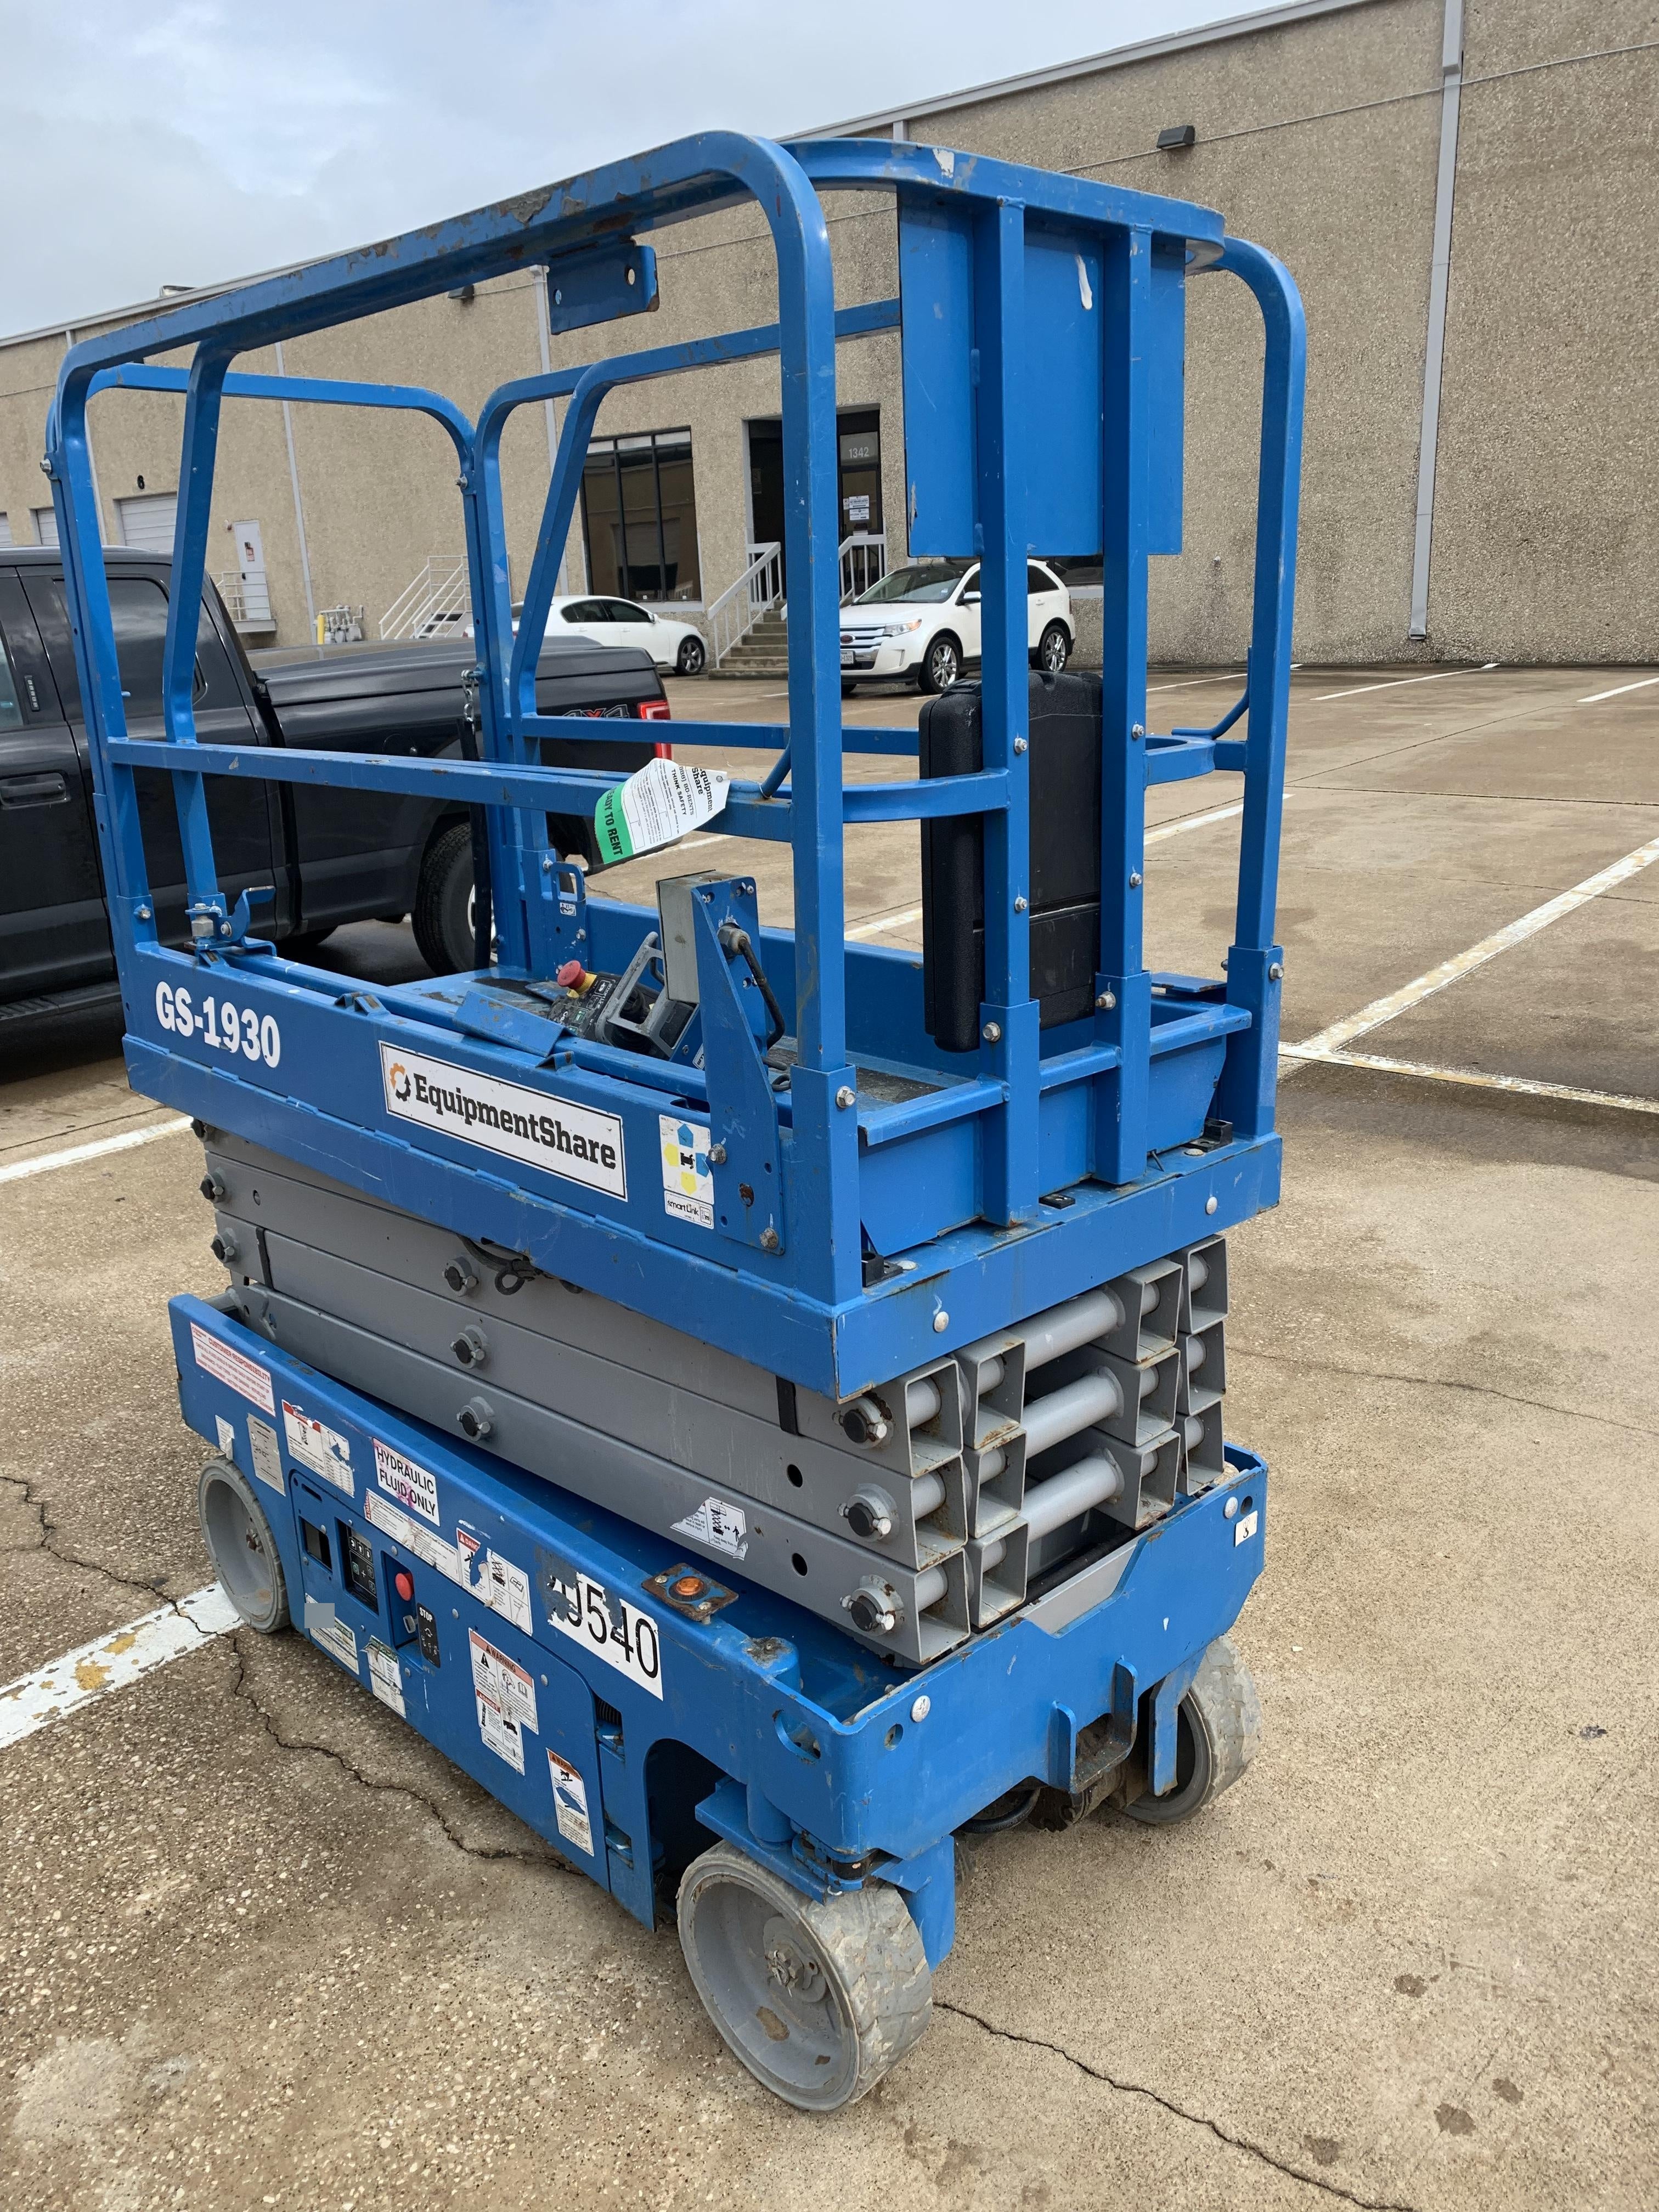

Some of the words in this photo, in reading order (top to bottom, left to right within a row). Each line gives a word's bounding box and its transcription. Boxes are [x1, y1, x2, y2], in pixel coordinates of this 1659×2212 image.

[849, 447, 870, 458] 1342
[137, 475, 145, 489] 6
[671, 769, 680, 790] THINK
[678, 791, 687, 815] SAFETY
[692, 768, 703, 795] Share
[699, 768, 713, 812] quipment
[605, 812, 614, 826] TO
[607, 828, 623, 855] RENT
[156, 981, 280, 1068] GS-1930
[413, 1073, 617, 1170] EquipmentShare
[208, 1338, 232, 1357] CUSTOMER
[377, 1447, 434, 1494] HYDRAULIC
[380, 1469, 407, 1497] FLUID
[411, 1489, 435, 1516] ONLY
[419, 1607, 433, 1622] STOP
[492, 1650, 516, 1673] WARNING
